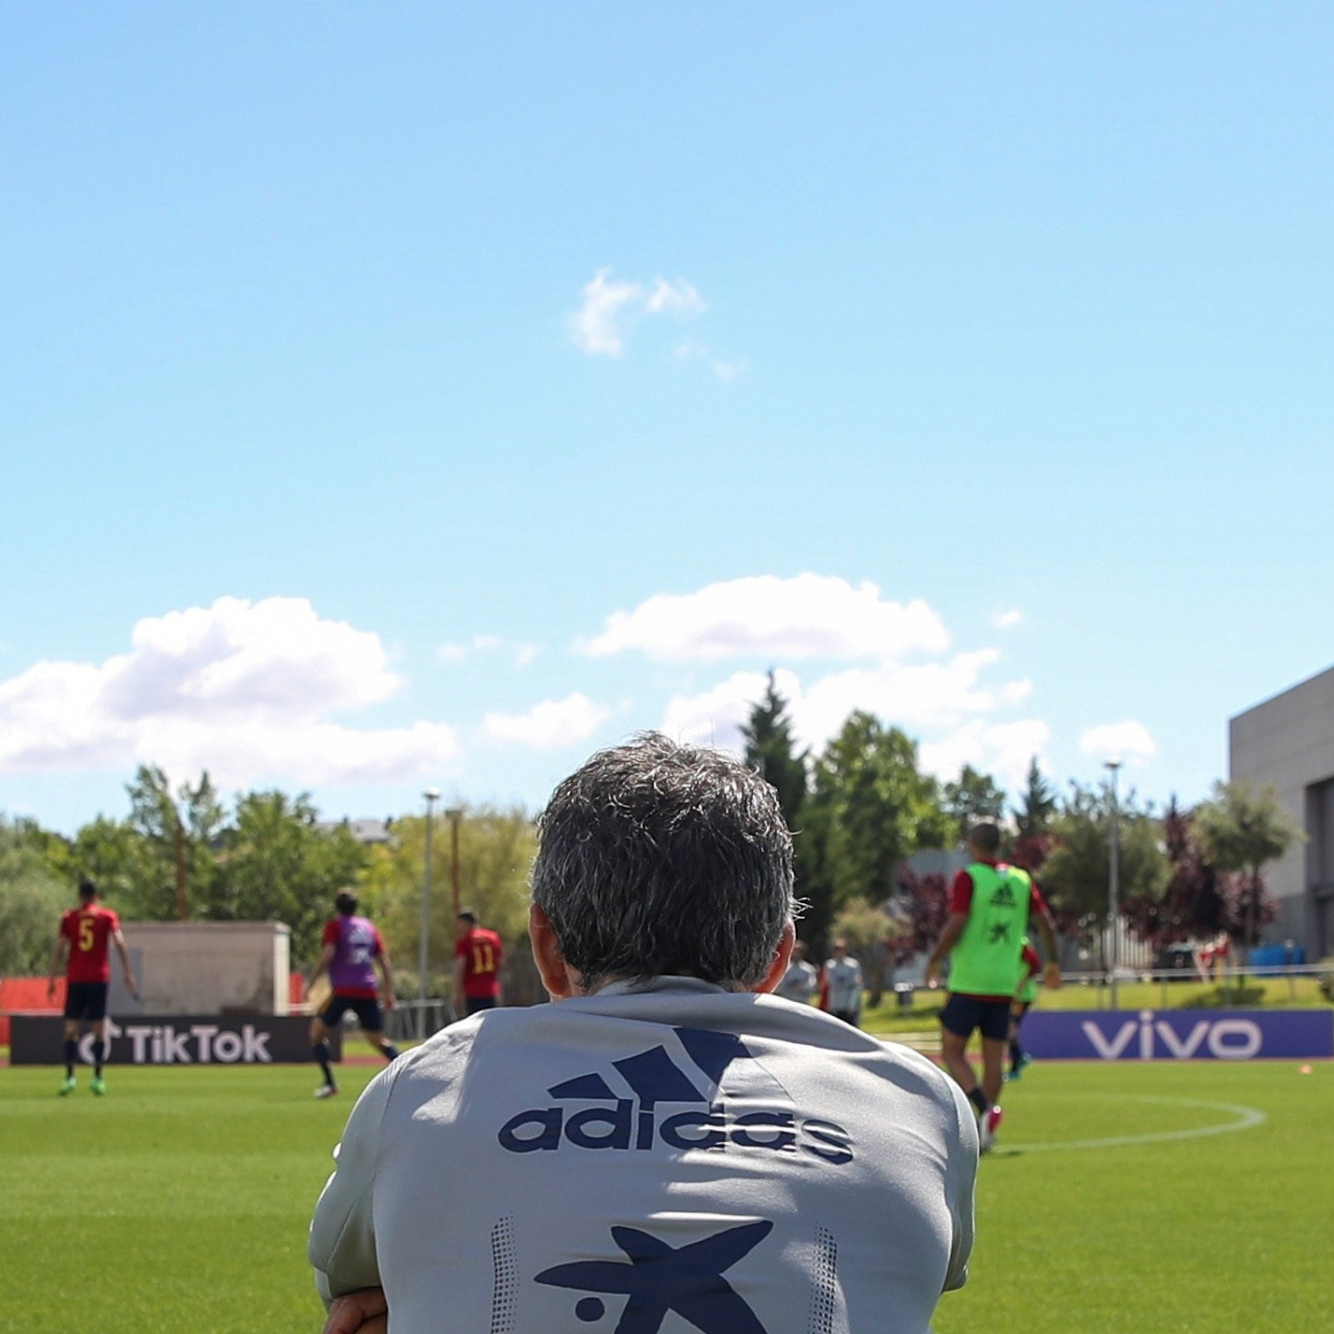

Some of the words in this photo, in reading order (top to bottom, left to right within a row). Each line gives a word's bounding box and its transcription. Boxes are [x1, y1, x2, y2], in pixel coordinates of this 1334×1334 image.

[79, 918, 94, 952] 5
[473, 944, 494, 974] 11
[125, 1025, 272, 1063] TikTok
[1081, 1009, 1263, 1060] vivo
[498, 1099, 854, 1165] adidas
